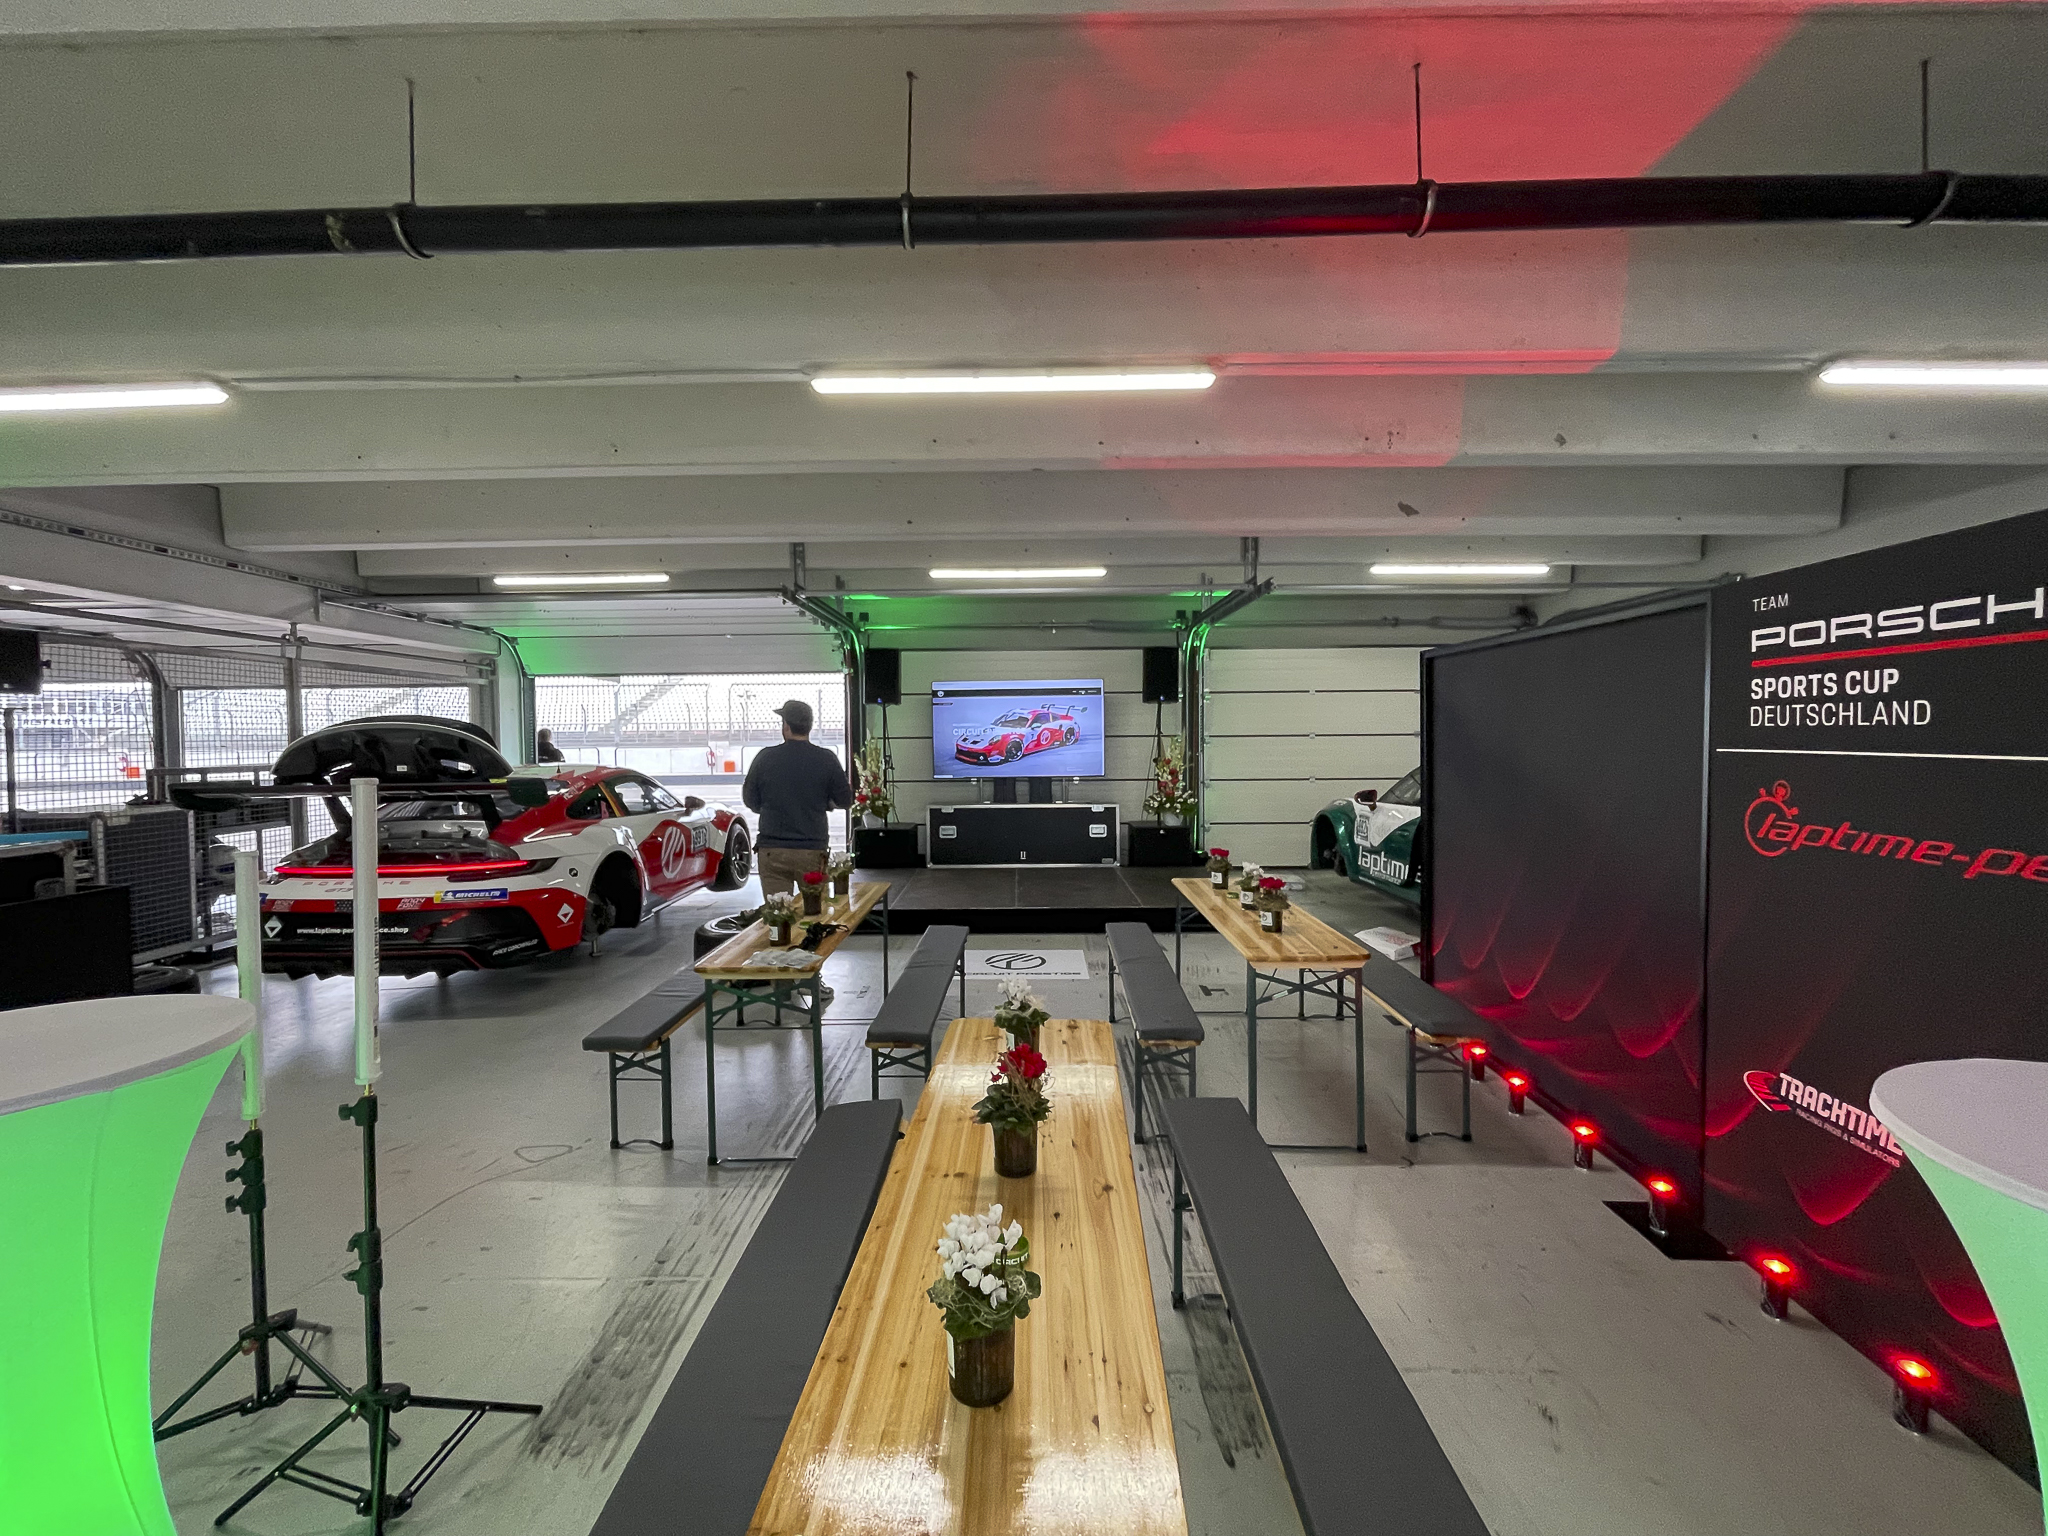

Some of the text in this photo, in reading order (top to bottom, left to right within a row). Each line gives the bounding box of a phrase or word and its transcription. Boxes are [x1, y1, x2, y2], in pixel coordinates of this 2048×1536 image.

[1752, 593, 1789, 612] TEAM
[1750, 668, 1900, 700] SPORTS CUP
[1750, 699, 1932, 727] DEUTSCHLAND
[455, 890, 501, 898] MICHELIN
[296, 926, 409, 935] www.laptime-perce.shop
